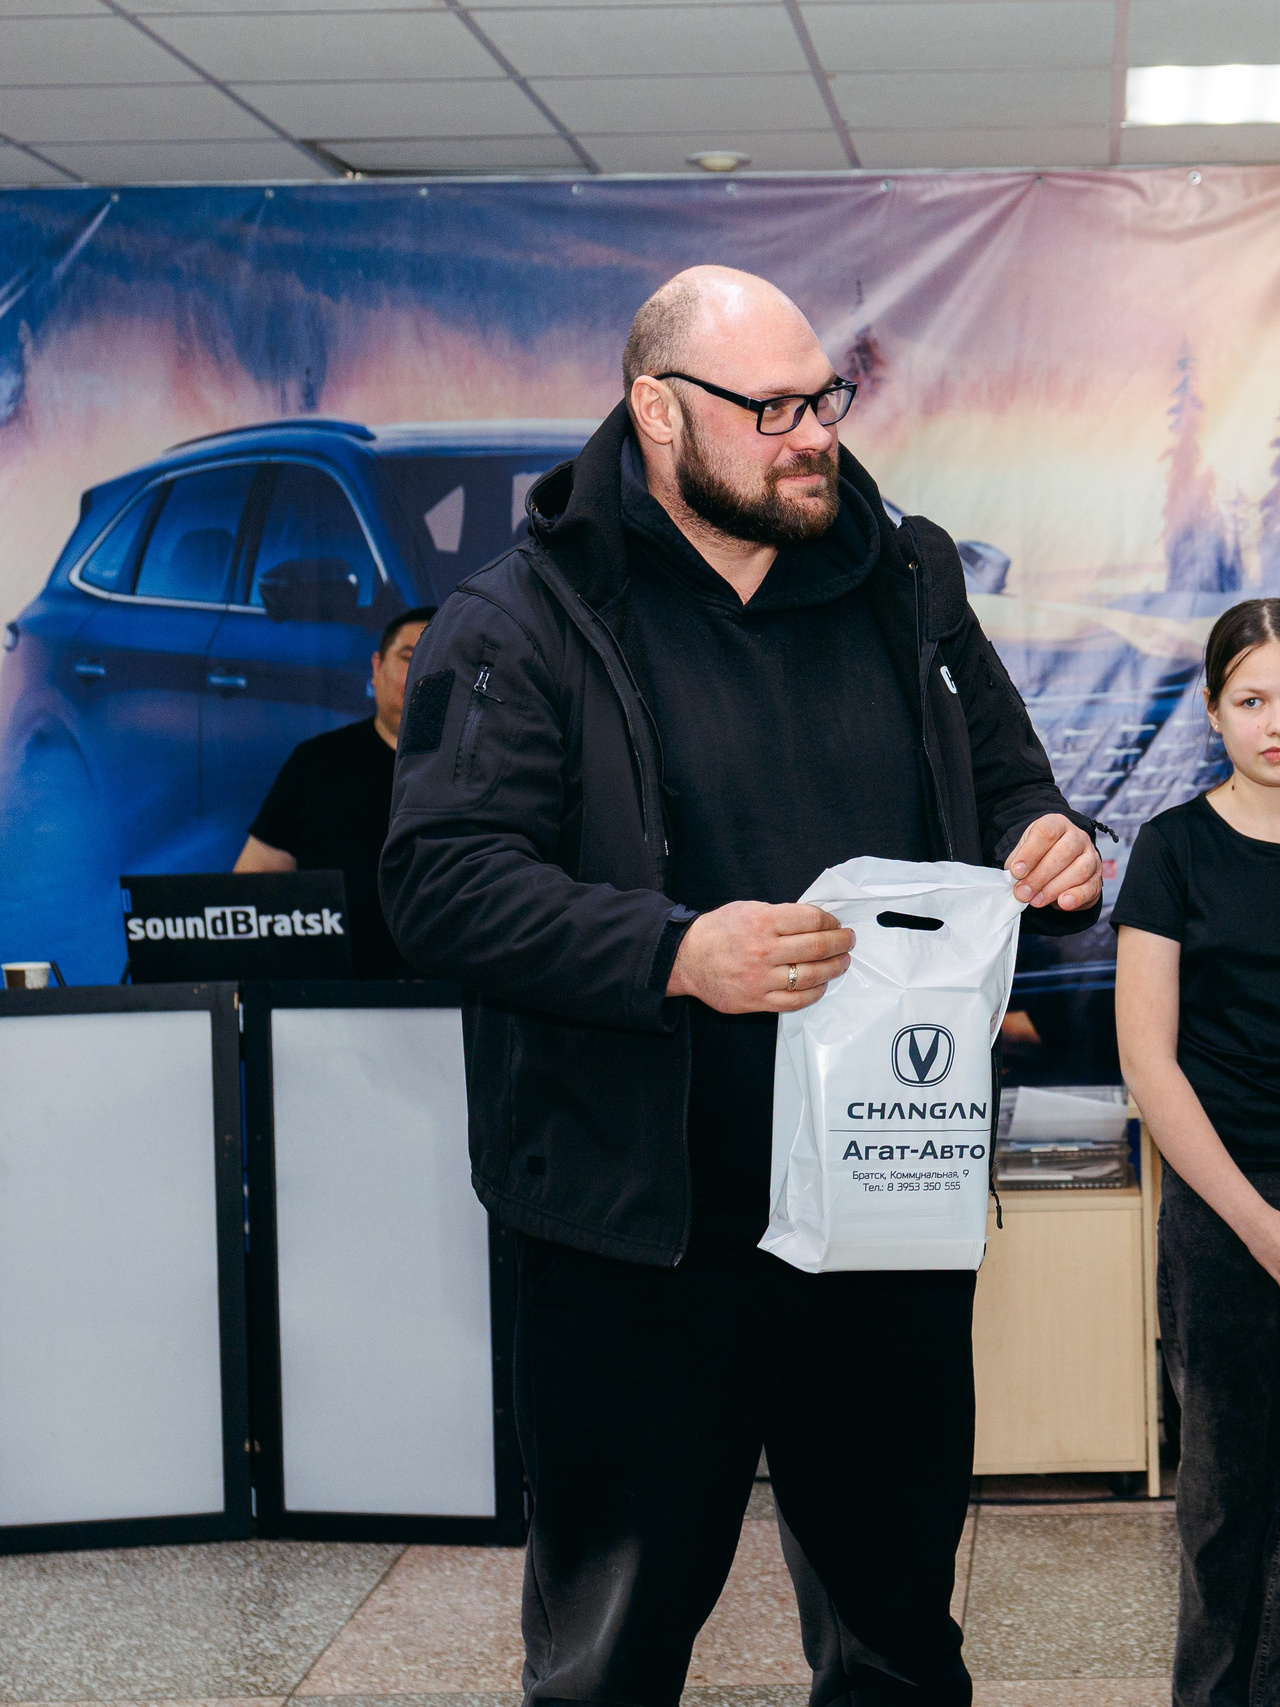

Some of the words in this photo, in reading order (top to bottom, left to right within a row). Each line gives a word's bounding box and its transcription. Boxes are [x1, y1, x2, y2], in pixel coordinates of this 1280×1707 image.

[127, 905, 345, 941] soundBratsk
[847, 1102, 987, 1120] CHANGAN
[842, 1139, 986, 1160] Агат-Авто
[852, 1170, 887, 1181] Братск,
[890, 1170, 959, 1181] Коммунальная,
[962, 1169, 970, 1178] 9
[863, 1182, 884, 1191] Тел.:
[887, 1182, 894, 1191] 8
[896, 1182, 920, 1191] 3953
[923, 1182, 941, 1191] 350
[944, 1181, 961, 1190] 555
